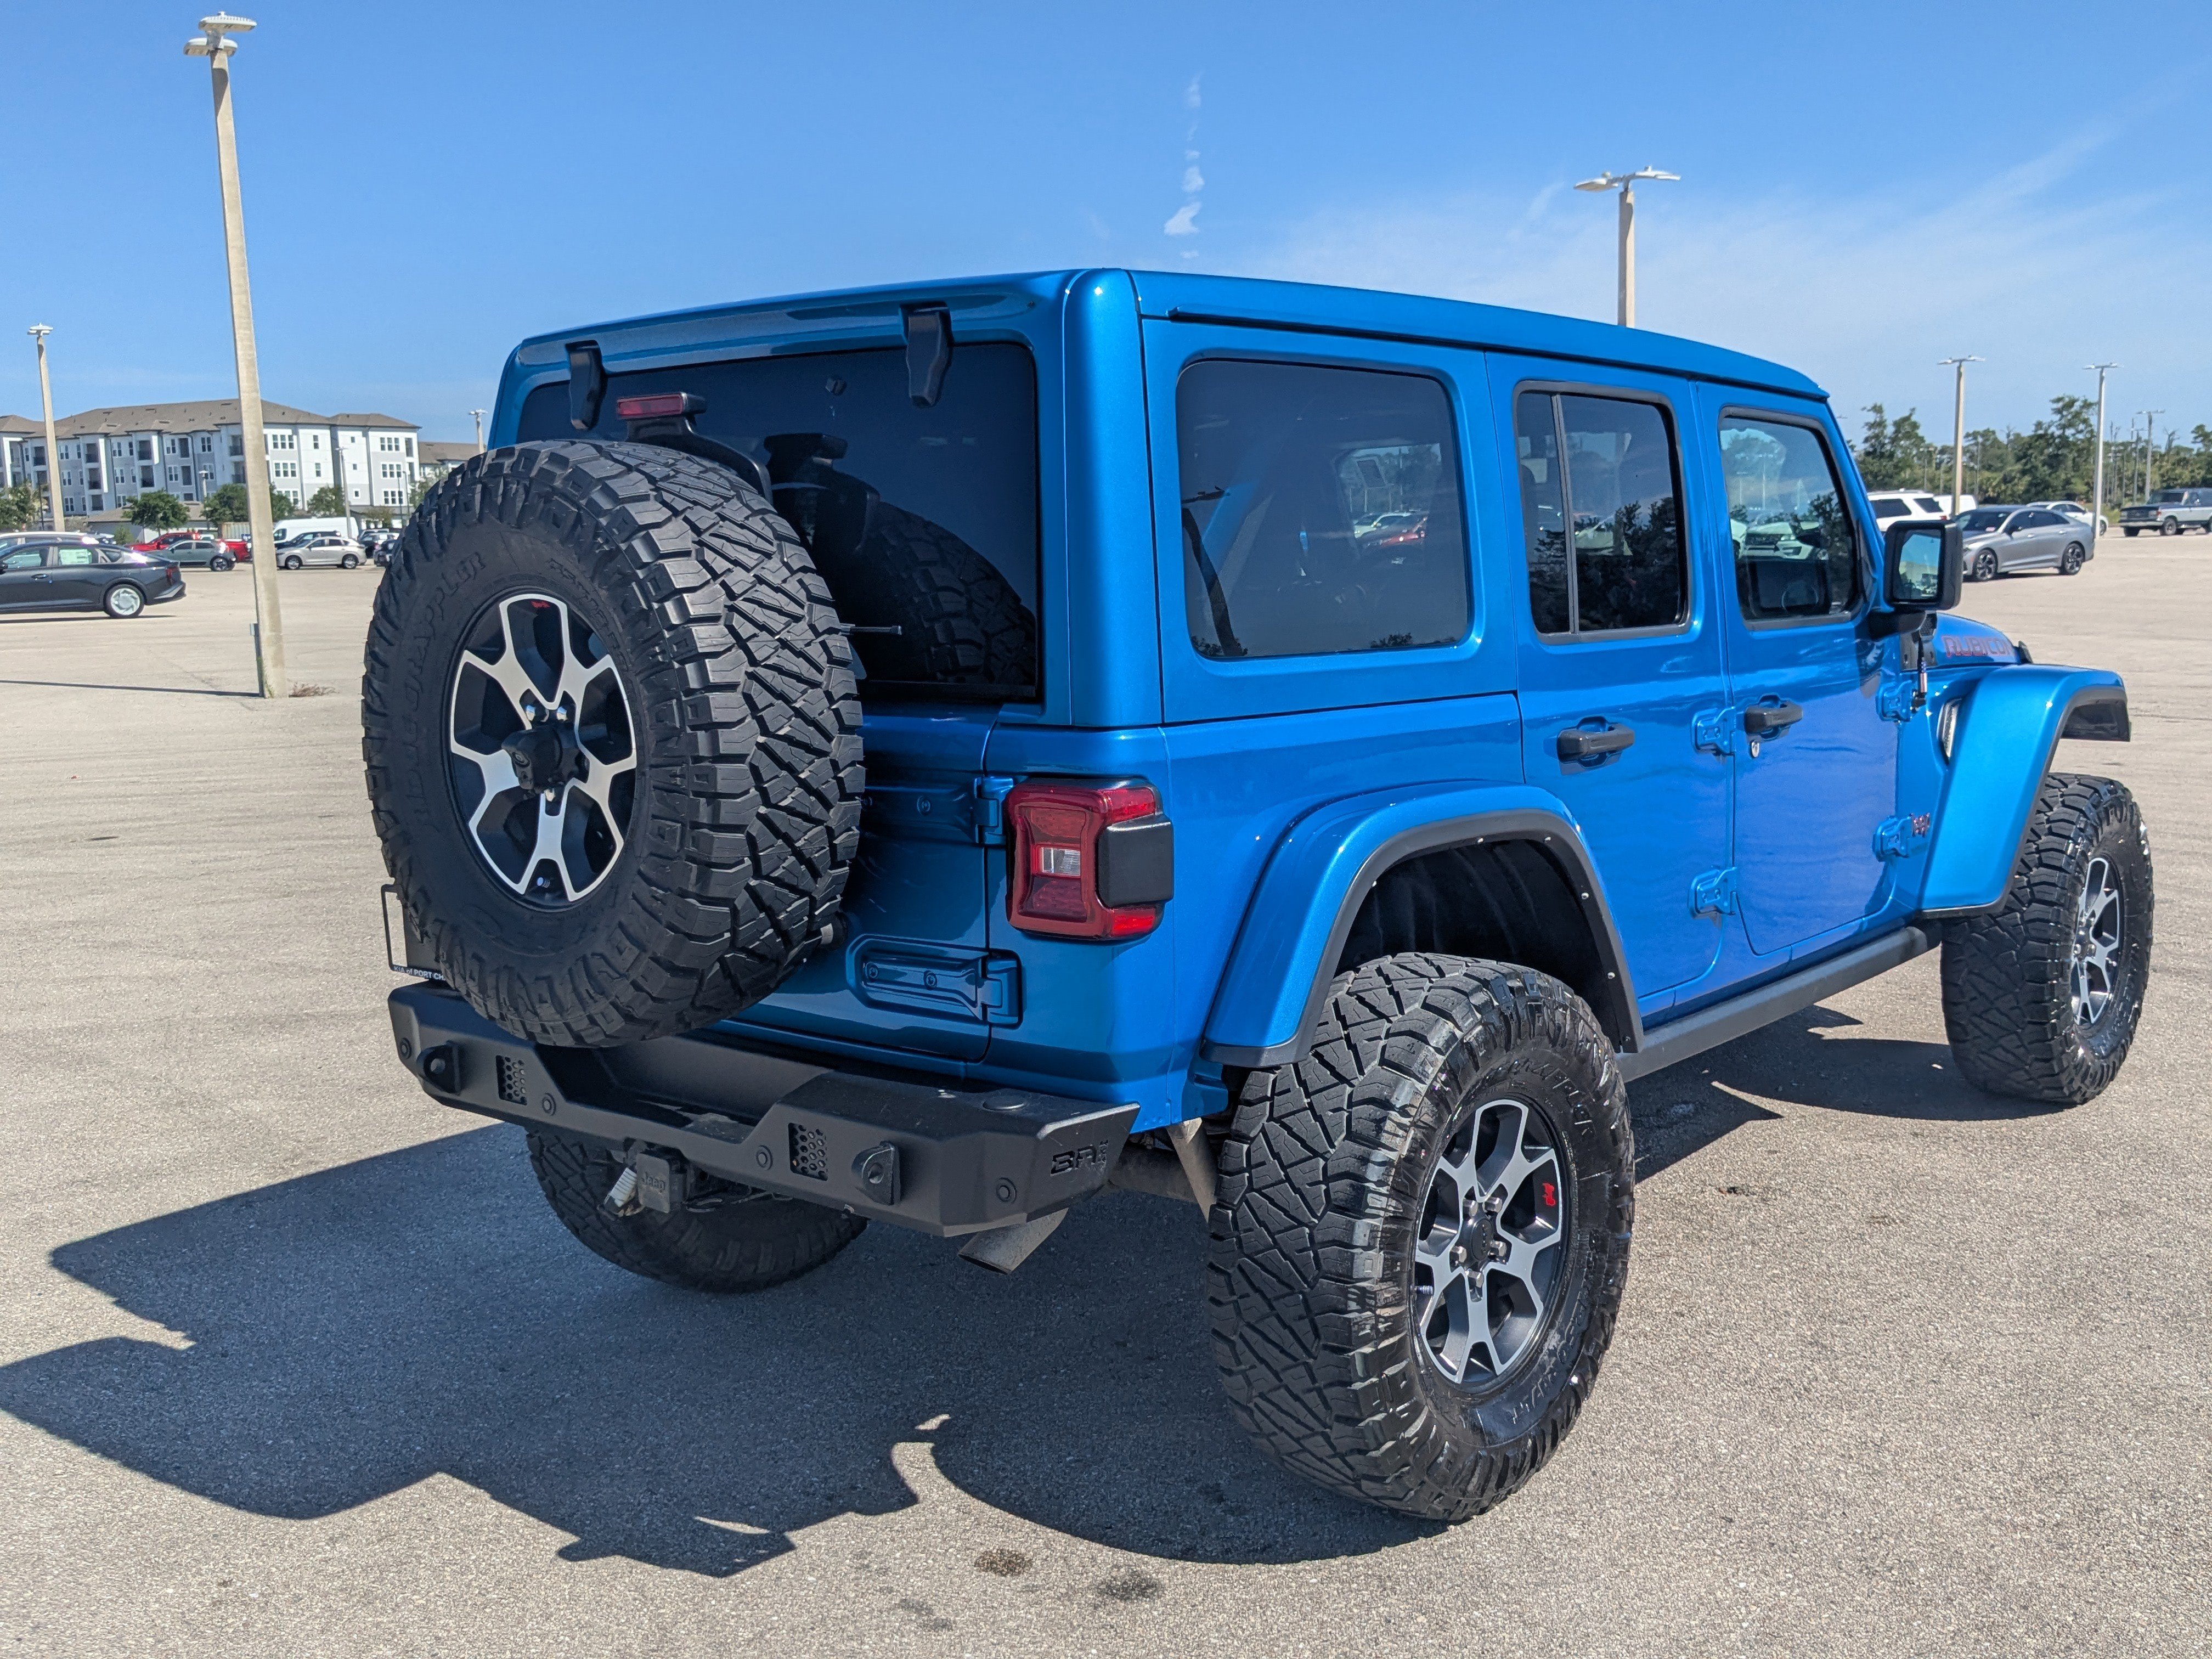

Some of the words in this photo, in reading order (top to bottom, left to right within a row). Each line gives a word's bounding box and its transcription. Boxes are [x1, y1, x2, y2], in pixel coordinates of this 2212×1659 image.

[414, 969, 432, 978] PORT
[433, 973, 446, 981] CH
[641, 1172, 665, 1193] Jeep
